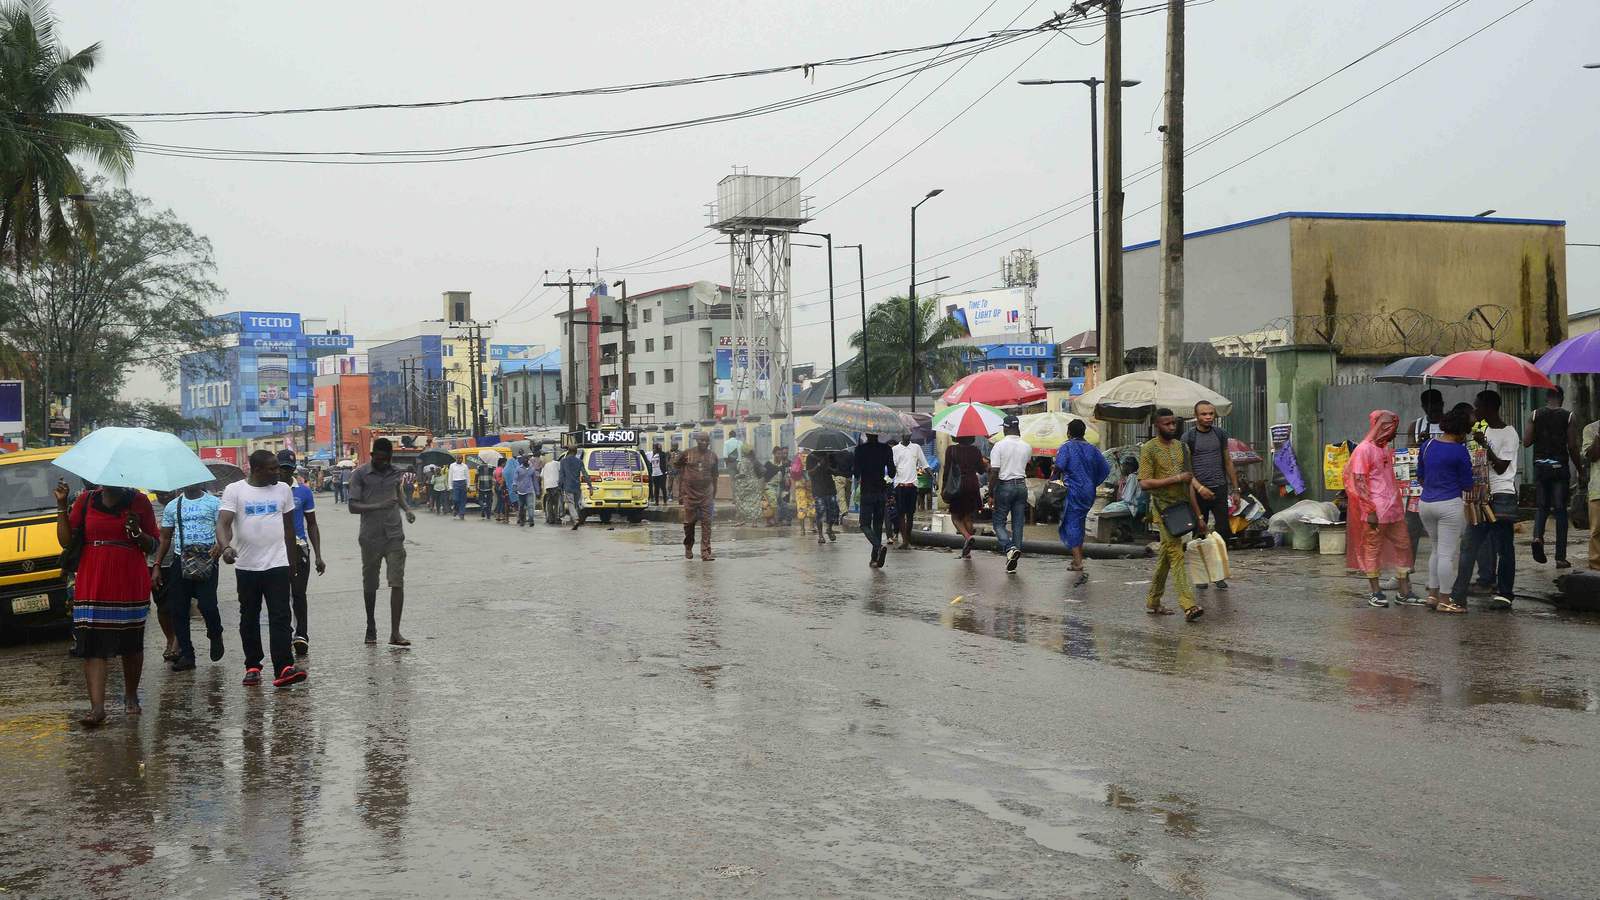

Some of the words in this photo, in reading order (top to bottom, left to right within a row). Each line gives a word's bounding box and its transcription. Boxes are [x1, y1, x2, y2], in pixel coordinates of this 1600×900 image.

[969, 300, 981, 310] TIME
[981, 299, 988, 308] TO
[975, 310, 992, 320] LIGHT
[993, 309, 1002, 318] UP
[250, 316, 292, 328] TECNO
[311, 336, 349, 346] TECNO
[1006, 345, 1046, 357] TECNO
[188, 380, 231, 409] TECNO
[585, 430, 635, 443] 1gb-#500
